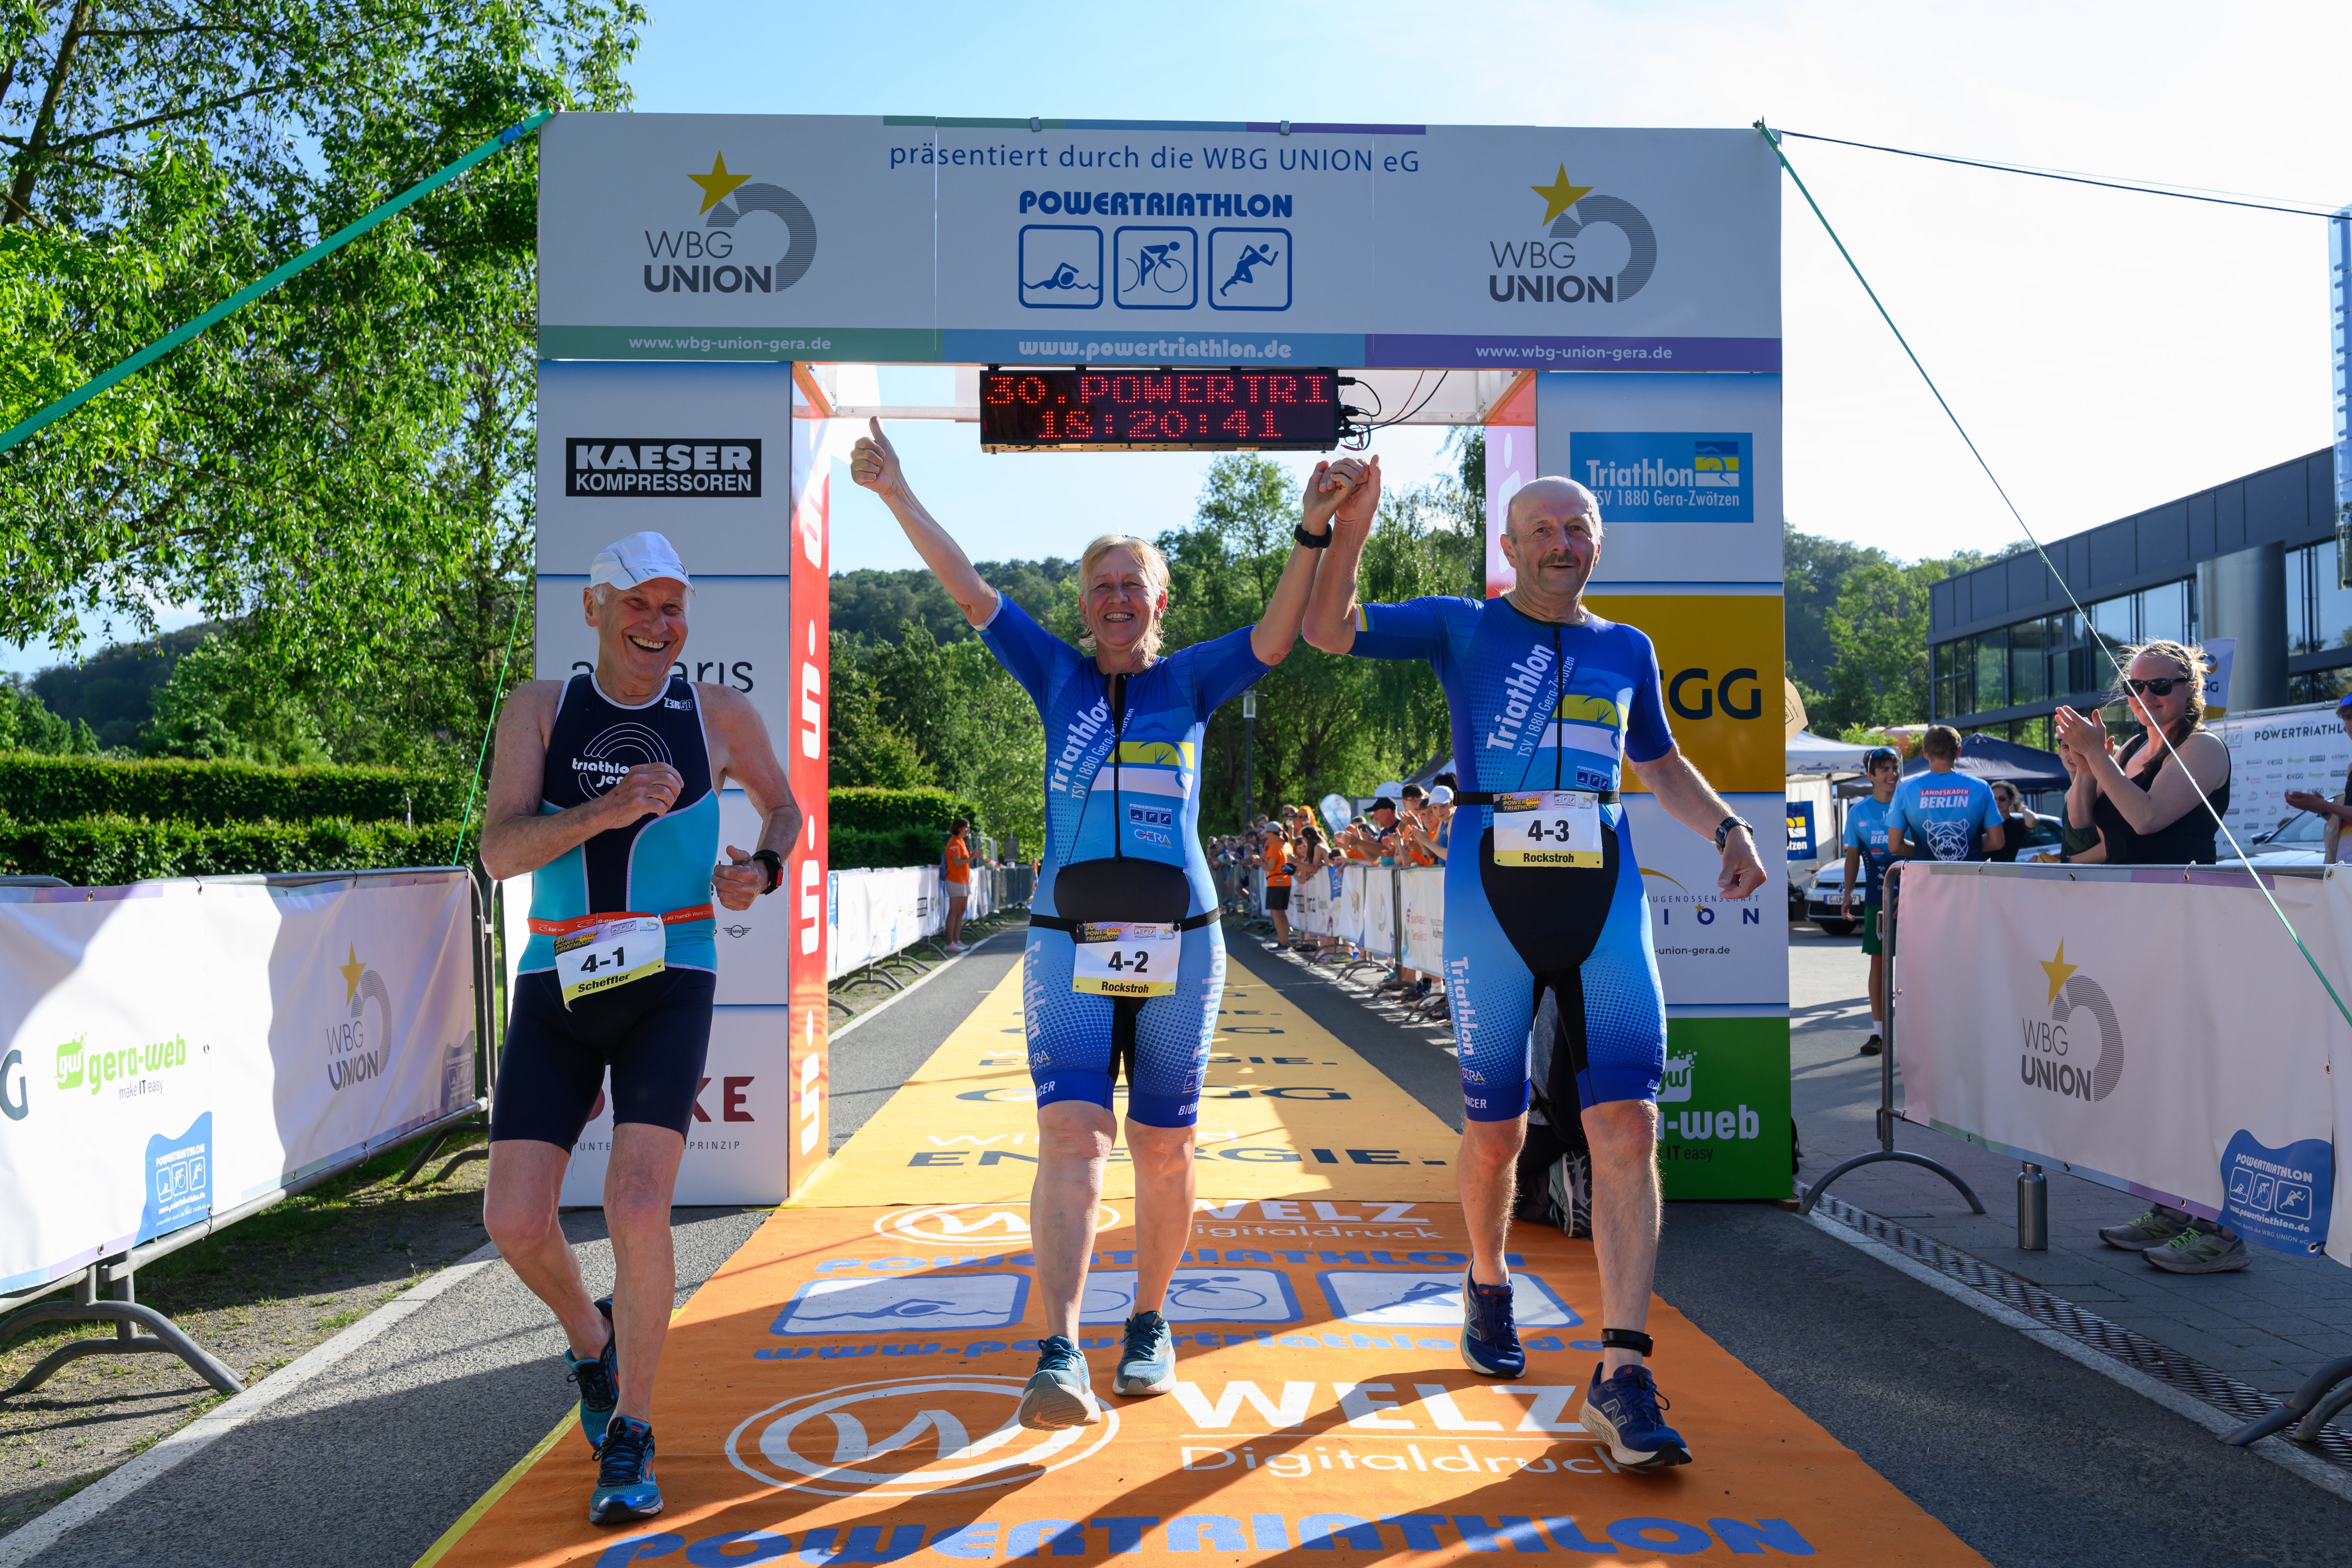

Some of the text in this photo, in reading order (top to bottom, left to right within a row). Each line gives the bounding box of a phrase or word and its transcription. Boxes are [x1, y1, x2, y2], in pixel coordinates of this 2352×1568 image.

[891, 142, 1420, 172] präsentiert durch die WBG UNION eG
[1019, 190, 1293, 218] POWERTRIATHLON
[645, 230, 733, 259] WBG
[1490, 241, 1576, 269] WBG
[644, 264, 771, 294] UNION
[1489, 275, 1613, 304] UNION
[629, 337, 831, 353] www.wbg-union-gera.de
[1019, 337, 1293, 361] www.powertriathlon.de
[1475, 344, 1673, 362] www.wbg-union-gera.de
[1037, 410, 1282, 439] 18:20:41
[575, 444, 752, 471] KAESER
[575, 473, 752, 491] KOMPRESSOREN
[1586, 458, 1693, 487] Triathlon
[1618, 490, 1649, 506] 1880
[1654, 489, 1740, 507] Gera-Zwötzen
[1486, 644, 1555, 750] Triathlon
[1659, 667, 1762, 720] GG
[1525, 712, 1547, 737] 1880
[1517, 739, 1535, 757] TSV
[572, 758, 633, 774] triathlo
[1076, 756, 1100, 780] 1880
[1071, 781, 1087, 800] TSV
[1919, 795, 1969, 809] BERLIN
[1504, 803, 1539, 812] TRIATHLON
[1134, 829, 1171, 845] GERA
[1527, 820, 1570, 842] 4-3
[1870, 835, 1889, 845] BER
[1523, 852, 1574, 863] Rockstroh
[555, 937, 580, 949] POWER
[555, 939, 593, 954] TRIATHLON
[1654, 946, 1731, 956] -union-gera.de
[580, 946, 625, 973] 4-1
[1108, 950, 1149, 973] 4-2
[578, 973, 631, 993] Scheffler
[1101, 981, 1149, 994] Rockstroh
[1446, 976, 1454, 997] 1880
[1192, 944, 1227, 1062] Triathlon
[1450, 956, 1479, 1056] Triathlon
[326, 1020, 364, 1056] WBG
[2022, 1017, 2069, 1057] WBG
[89, 1033, 186, 1096] gera-web
[327, 1051, 378, 1092] UNION
[1462, 1067, 1486, 1083] GERA
[119, 1078, 164, 1100] make IT easy
[2021, 1055, 2091, 1102] UNION
[156, 1143, 205, 1168] POWERTRIATHLON
[1666, 1145, 1681, 1160] IT
[1684, 1147, 1714, 1163] easy
[2235, 1153, 2313, 1183] POWERTRIATHLON
[2229, 1204, 2310, 1233] www.powertriathlon.de
[1194, 1224, 1445, 1239] igitaldruck
[2242, 1223, 2253, 1232] durch
[2262, 1229, 2275, 1238] WBG
[2276, 1233, 2298, 1243] UNION
[1176, 1380, 1589, 1433] WELZ
[1180, 1443, 1650, 1478] Digitaldruck
[595, 1513, 1816, 1568] POWERTRIATHLON
